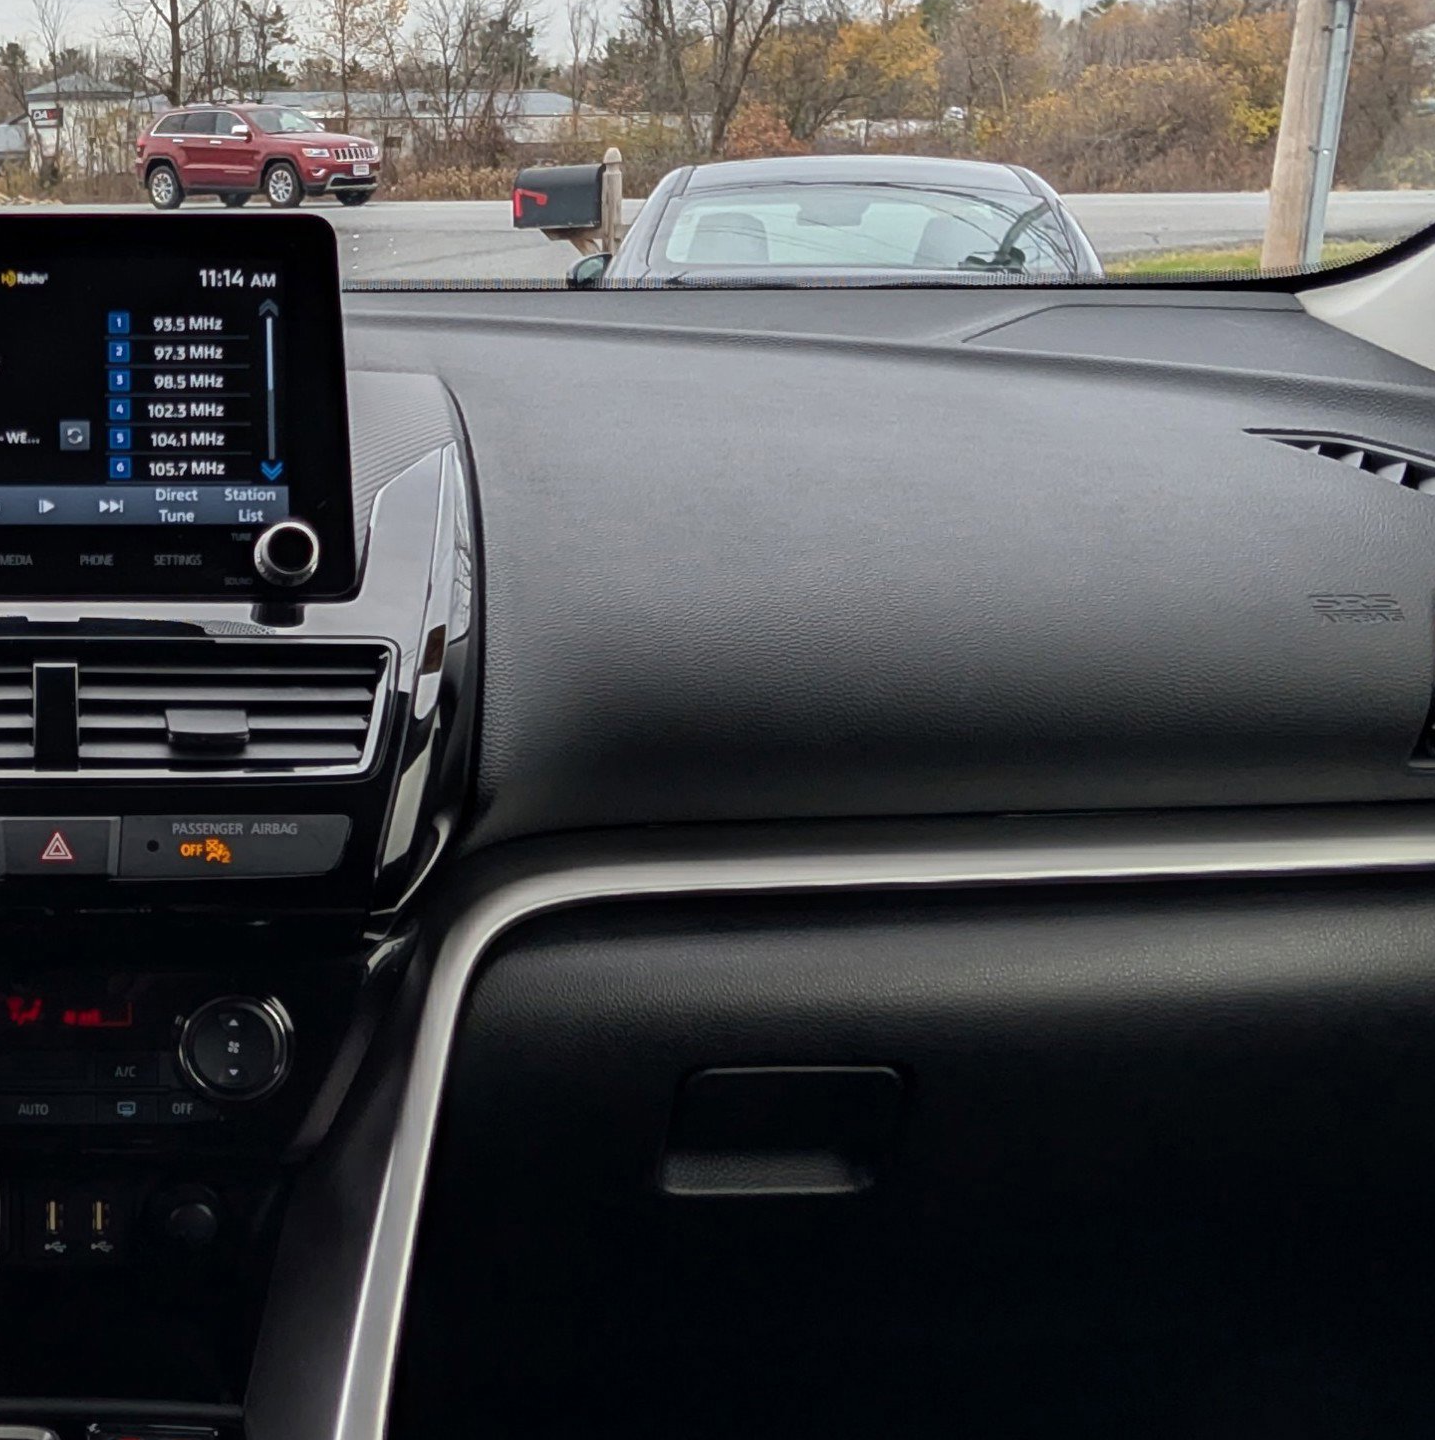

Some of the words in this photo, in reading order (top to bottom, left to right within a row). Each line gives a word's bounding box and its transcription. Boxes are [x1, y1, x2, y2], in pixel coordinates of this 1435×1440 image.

[199, 268, 245, 287] 11:14
[250, 273, 277, 288] AM
[115, 317, 122, 328] 1
[153, 317, 186, 332] 93.5
[188, 316, 223, 331] MHz
[116, 346, 123, 357] 2
[153, 346, 186, 361] 97.3
[189, 345, 223, 360] MHz
[116, 375, 123, 386] 3
[154, 375, 187, 390] 98.5
[189, 374, 224, 389] MHz
[116, 404, 124, 414] 4
[147, 403, 187, 419] 102.3
[190, 403, 225, 417] MHz
[116, 433, 124, 444] 5
[150, 432, 187, 448] 104.1
[190, 432, 225, 446] MHz
[117, 462, 124, 473] 6
[148, 461, 187, 477] 105.7
[191, 461, 226, 476] MHz
[155, 488, 199, 502] Direct
[224, 488, 276, 502] Station
[159, 508, 195, 522] Tune
[238, 508, 264, 522] List
[0, 554, 33, 567] MEDIA
[79, 554, 114, 567] PHONE
[153, 554, 203, 567] SETTINGS
[171, 822, 244, 836] PASSENGER
[251, 822, 298, 836] AIRBAG
[180, 842, 204, 857] OFF
[115, 1065, 137, 1079] A/C
[17, 1103, 50, 1116] AUTO
[172, 1102, 193, 1116] OFF
